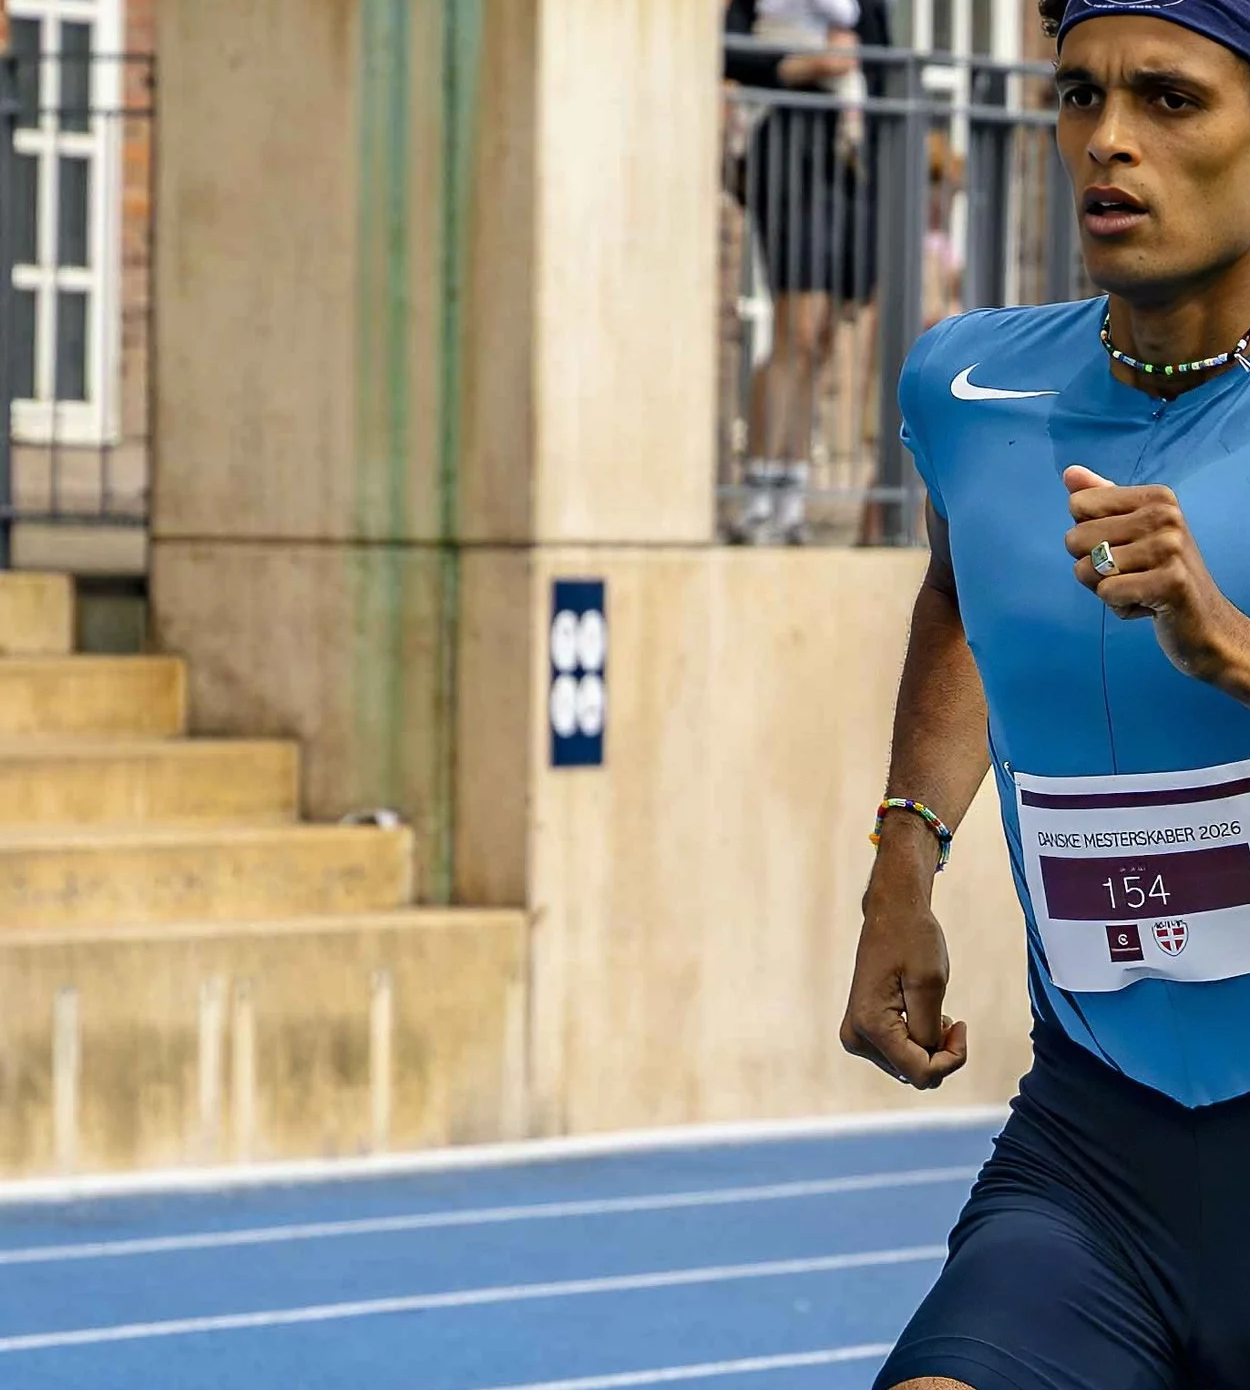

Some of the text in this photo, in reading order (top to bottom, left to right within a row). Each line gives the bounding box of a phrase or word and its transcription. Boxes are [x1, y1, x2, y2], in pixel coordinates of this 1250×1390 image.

[1038, 820, 1241, 848] DANSKE MESTERSKABER 2026
[1102, 874, 1172, 910] 154
